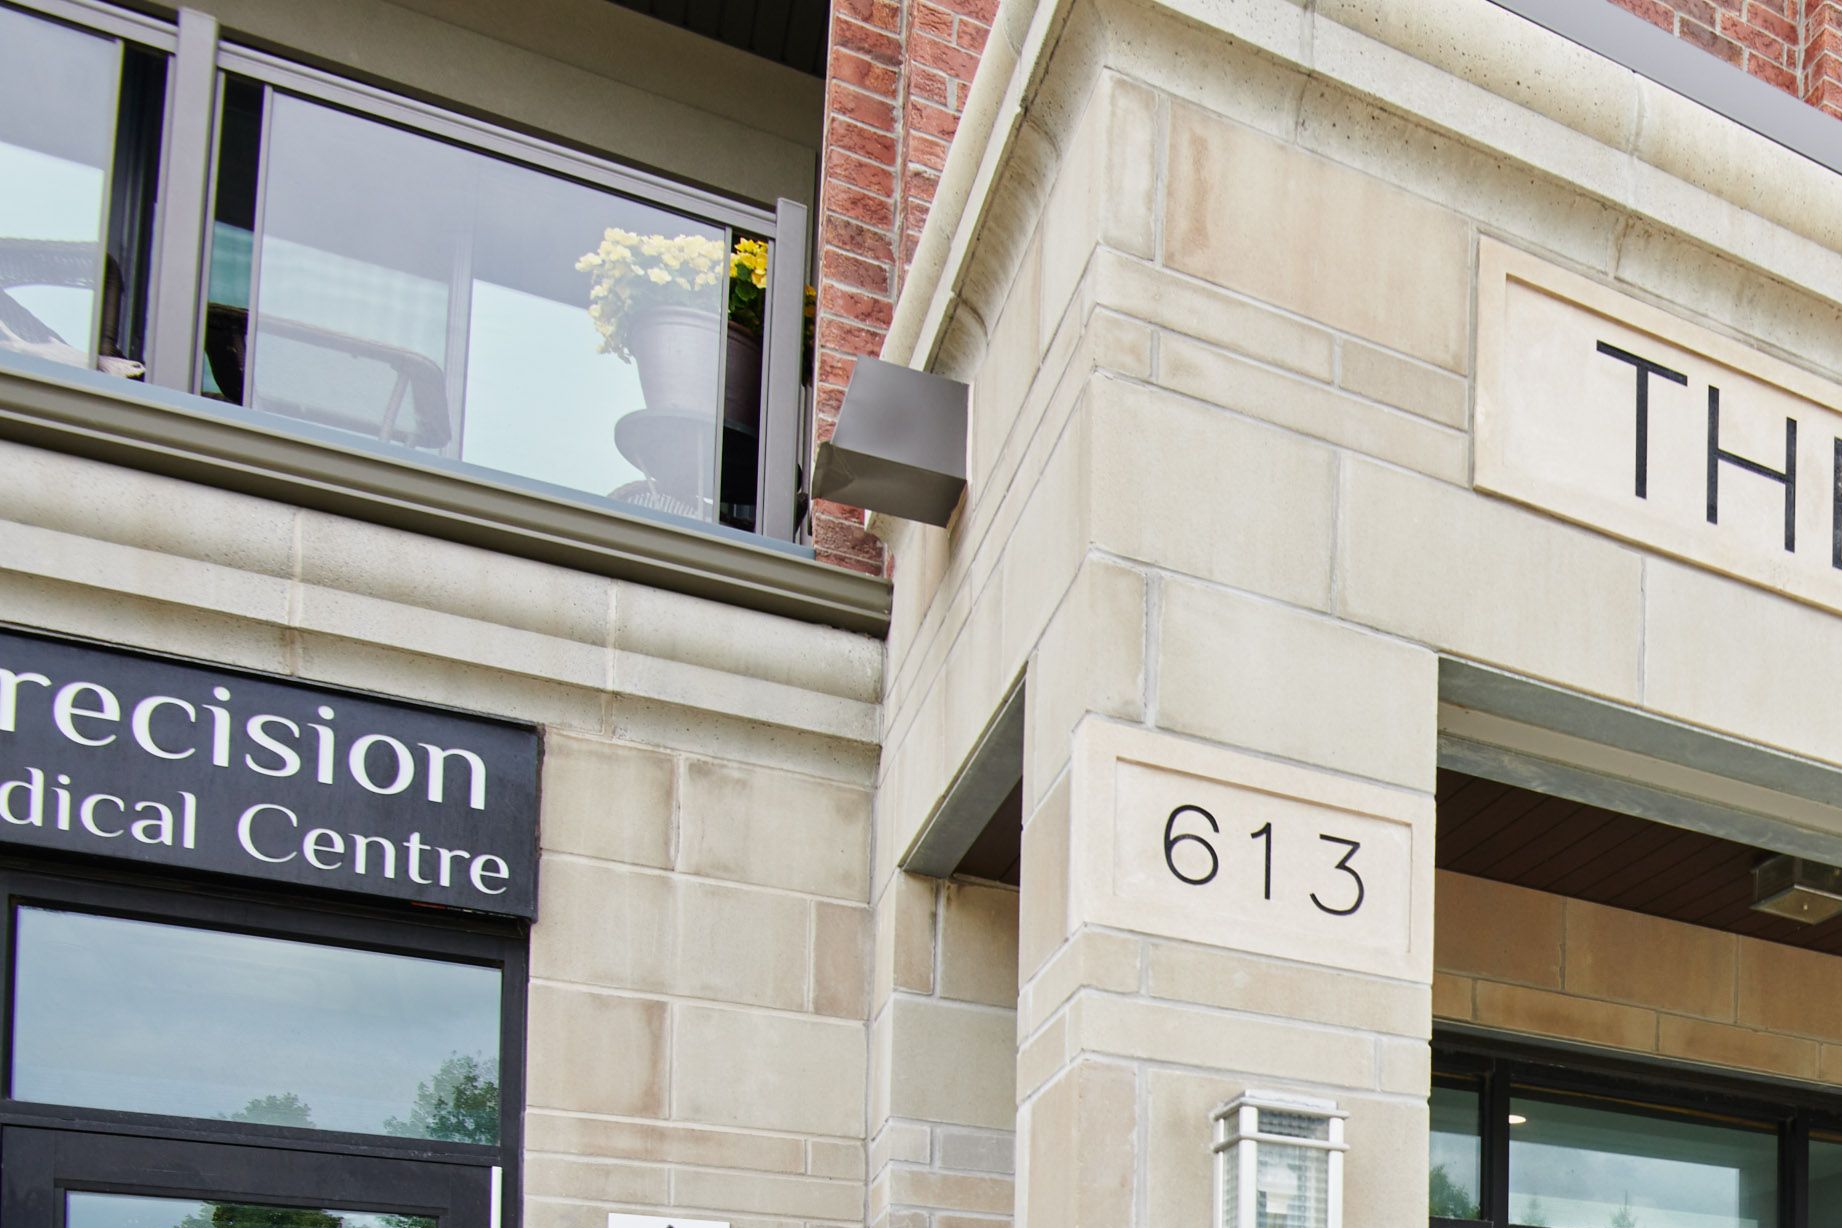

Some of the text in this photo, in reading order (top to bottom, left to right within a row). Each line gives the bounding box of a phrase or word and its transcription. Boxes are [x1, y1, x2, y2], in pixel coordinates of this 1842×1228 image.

[0, 668, 487, 811] recision
[0, 765, 510, 895] dical Centre
[1163, 803, 1365, 917] 613
